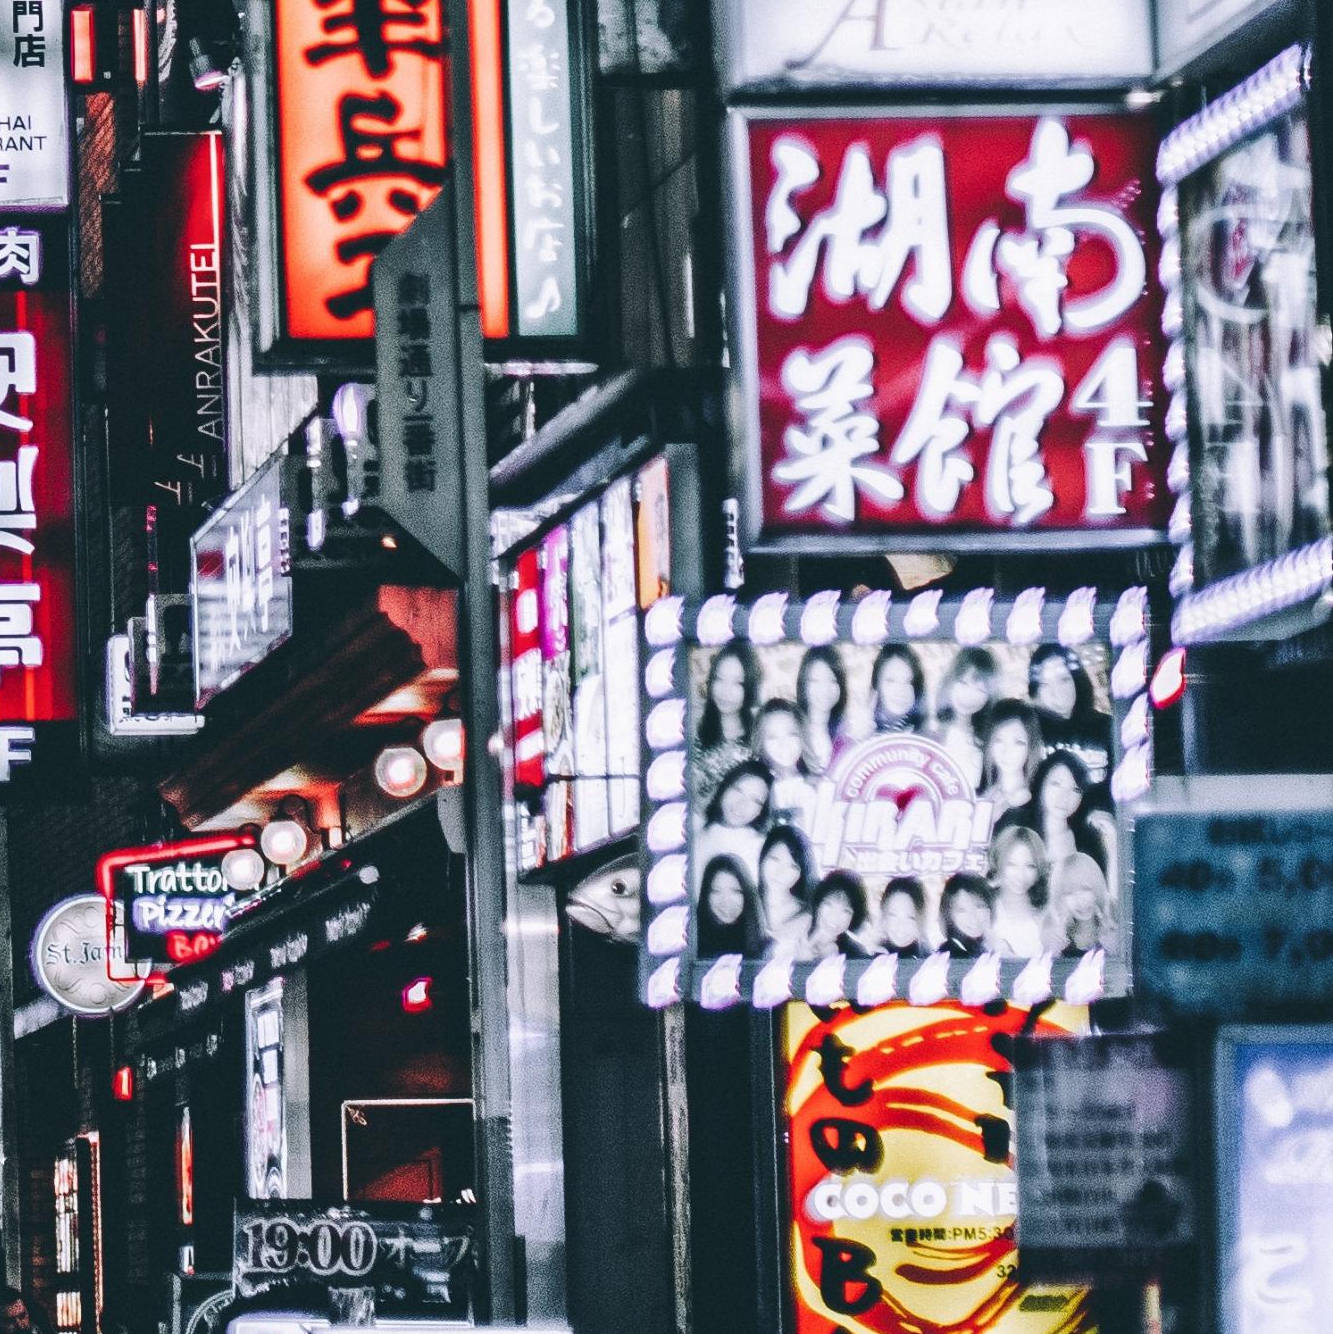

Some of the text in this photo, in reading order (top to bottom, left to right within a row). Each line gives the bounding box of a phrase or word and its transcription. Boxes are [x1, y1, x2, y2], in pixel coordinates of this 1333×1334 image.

[190, 242, 223, 440] ANRAKUTEI
[811, 1179, 948, 1221] COCO
[243, 1217, 378, 1276] 19:00
